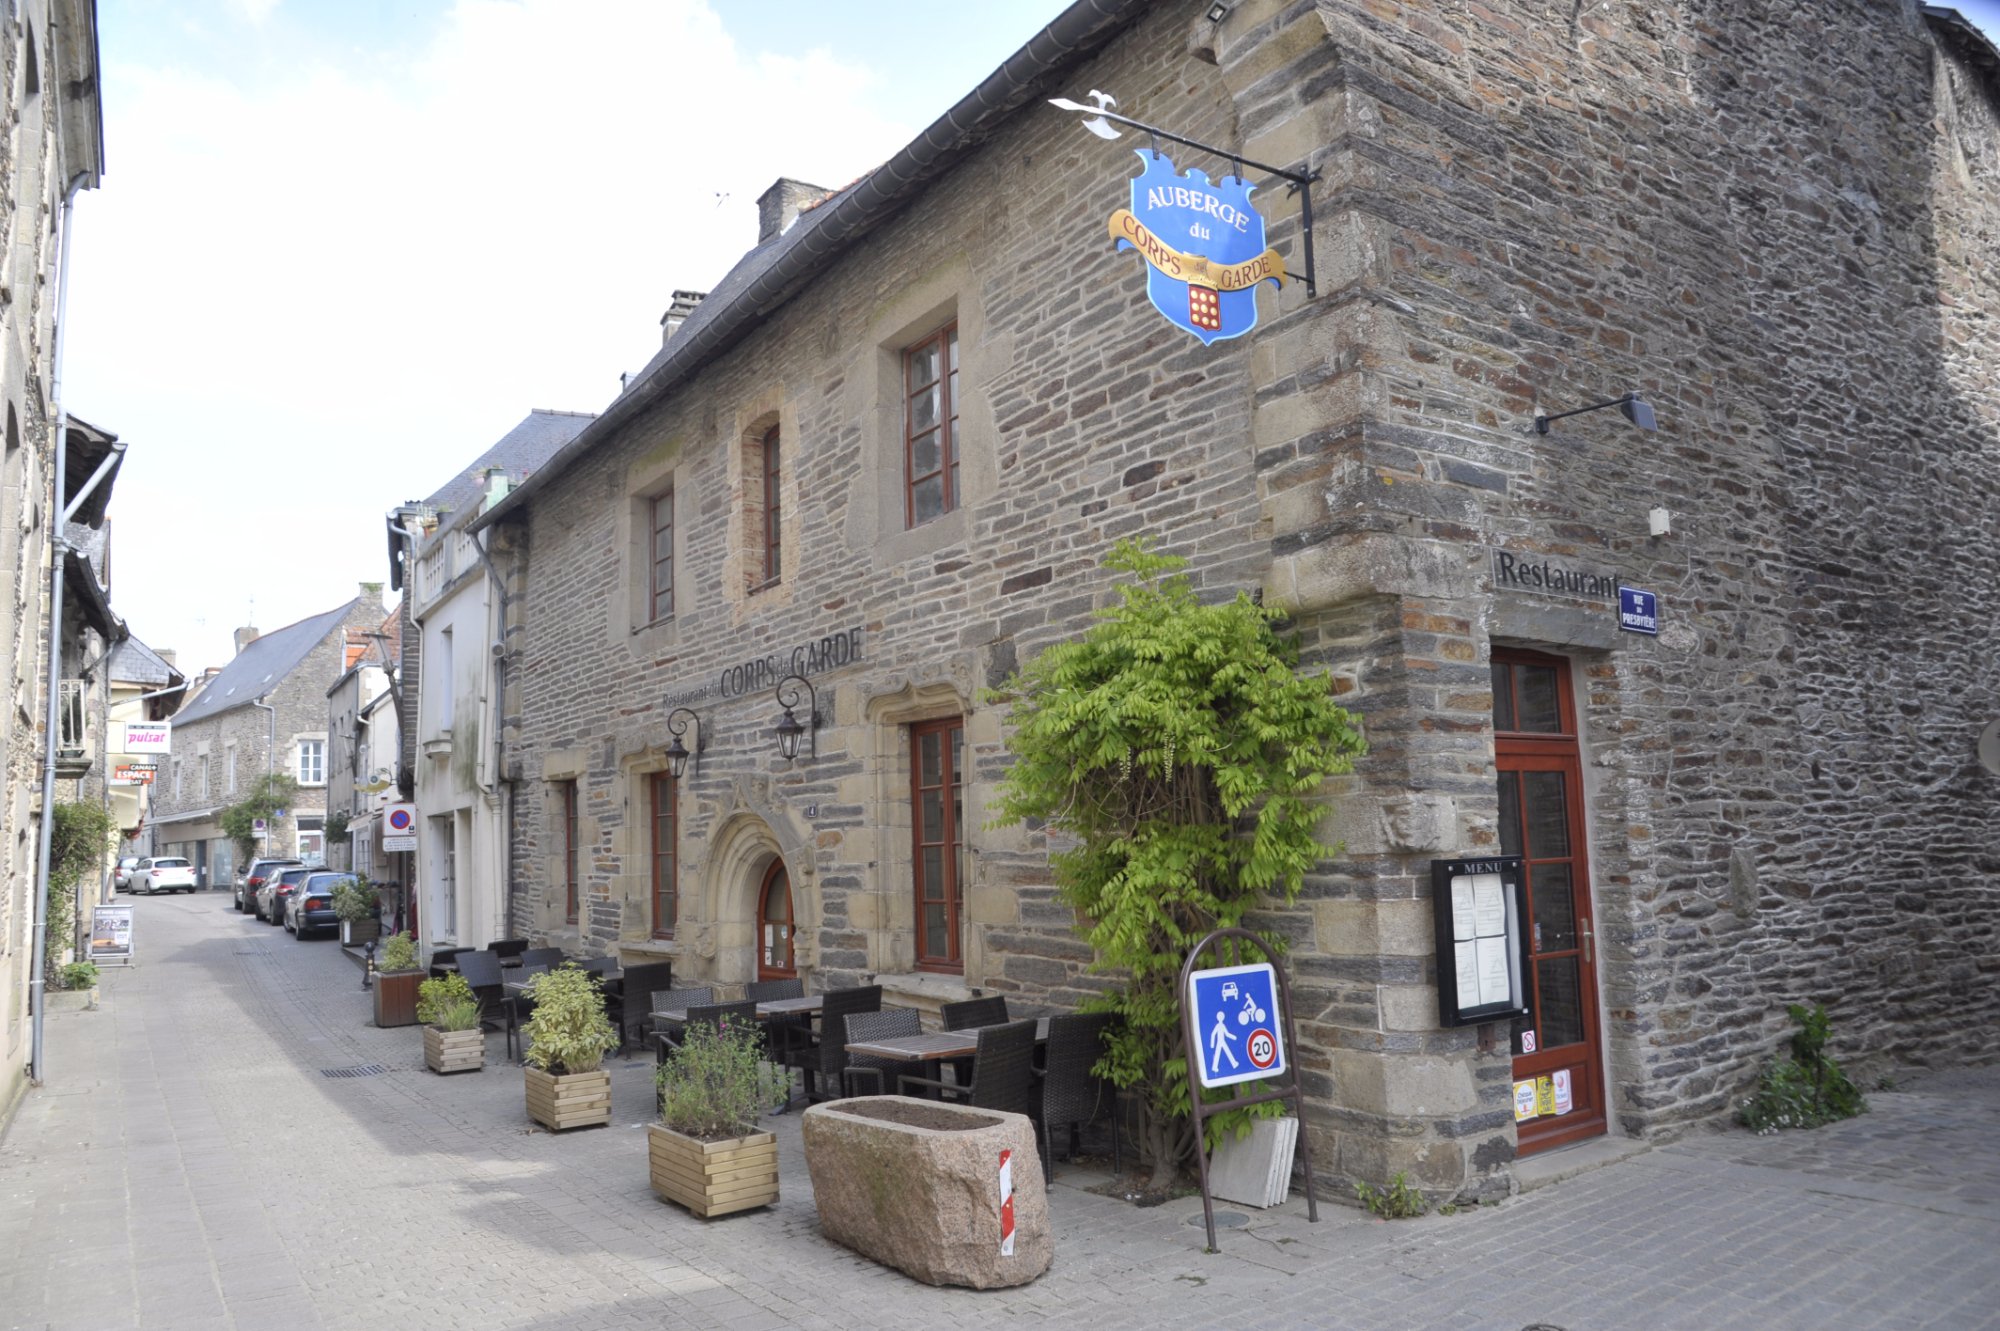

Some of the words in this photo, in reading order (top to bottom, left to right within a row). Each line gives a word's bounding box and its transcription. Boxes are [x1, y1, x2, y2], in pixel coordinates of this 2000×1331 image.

[1148, 186, 1249, 233] AUBERGE
[1189, 222, 1210, 240] du
[1123, 215, 1182, 275] CORPS
[1221, 256, 1271, 289] GARDE
[1499, 551, 1620, 599] Restaurant
[663, 687, 706, 709] Restaurant
[721, 654, 775, 698] CORPS
[791, 625, 864, 677] GARDE
[128, 732, 166, 744] pulsat
[116, 771, 151, 779] ESPACE
[1464, 862, 1502, 874] MENU
[1254, 1041, 1270, 1056] 20
